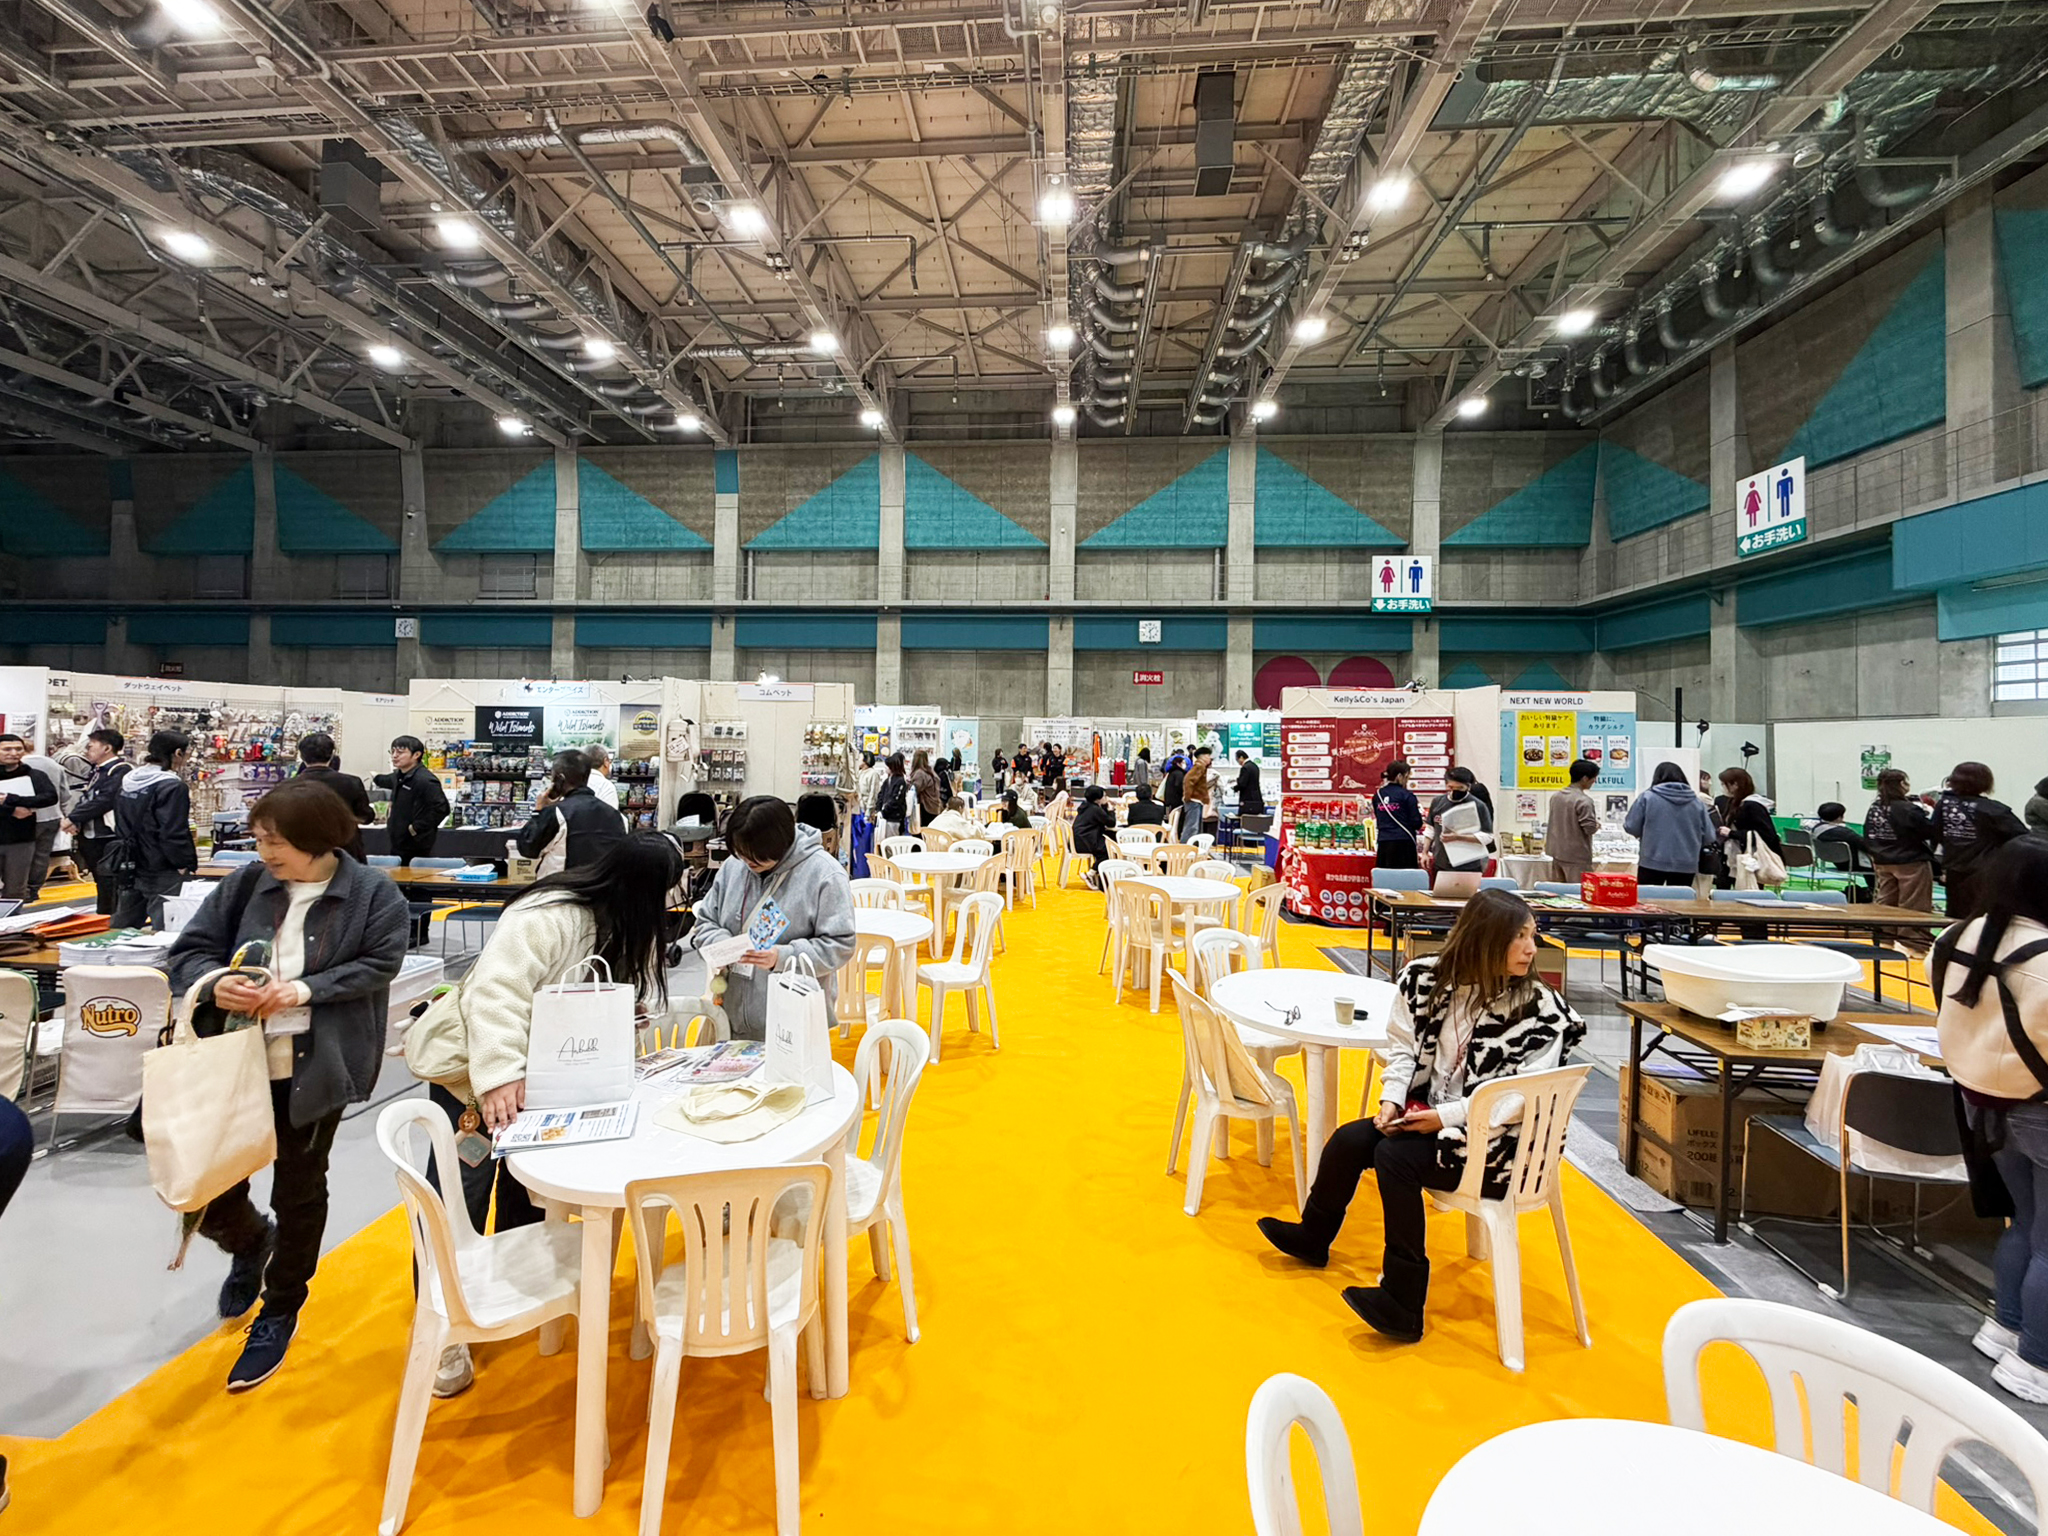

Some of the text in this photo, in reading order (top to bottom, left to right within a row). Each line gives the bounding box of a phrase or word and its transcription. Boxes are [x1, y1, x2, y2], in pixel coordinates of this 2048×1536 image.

[1752, 524, 1801, 549] お手洗い
[1387, 599, 1430, 610] お手洗い
[1140, 674, 1161, 682] 消火栓
[1334, 695, 1405, 705] Kelly&Co's Japan
[1509, 697, 1584, 706] NEXT NEW WORLD
[1529, 776, 1564, 784] SILKFULL
[81, 1004, 138, 1032] Nutro
